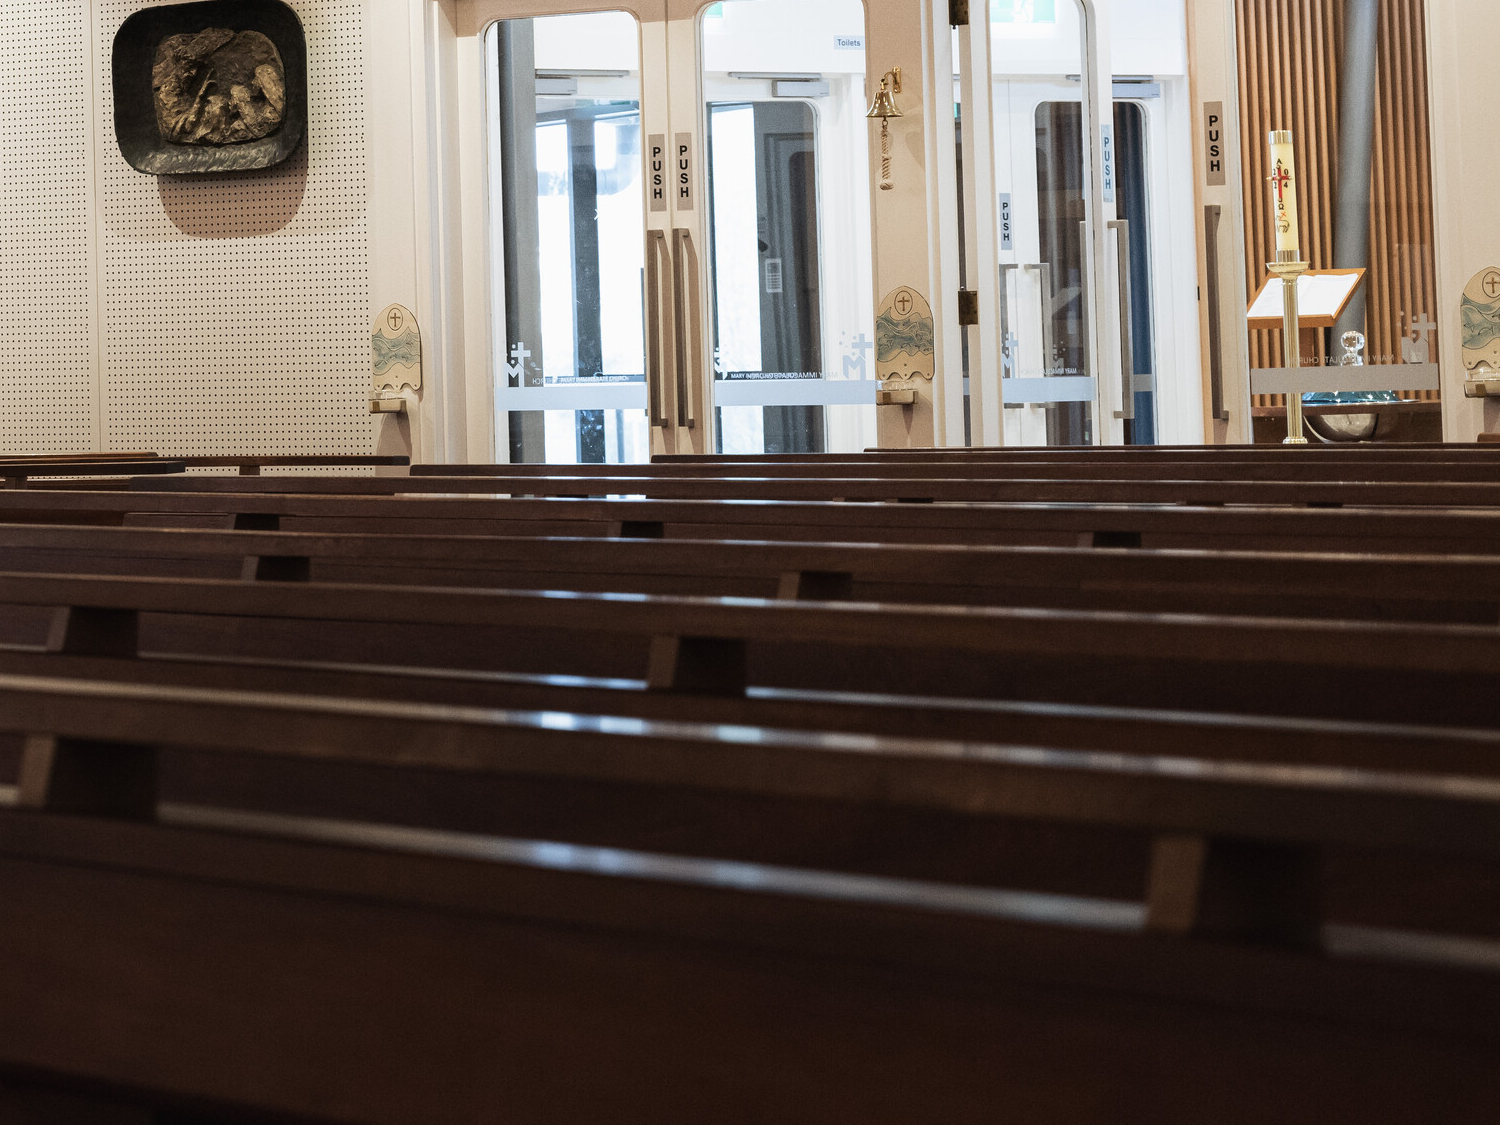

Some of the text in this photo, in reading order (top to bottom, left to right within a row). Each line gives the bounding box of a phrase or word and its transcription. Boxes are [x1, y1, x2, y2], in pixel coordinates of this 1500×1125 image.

[837, 39, 861, 47] Toilets
[1209, 114, 1221, 172] PUSH
[653, 146, 663, 199] PUSH
[679, 145, 689, 198] PUSH
[1002, 202, 1010, 241] PUSH
